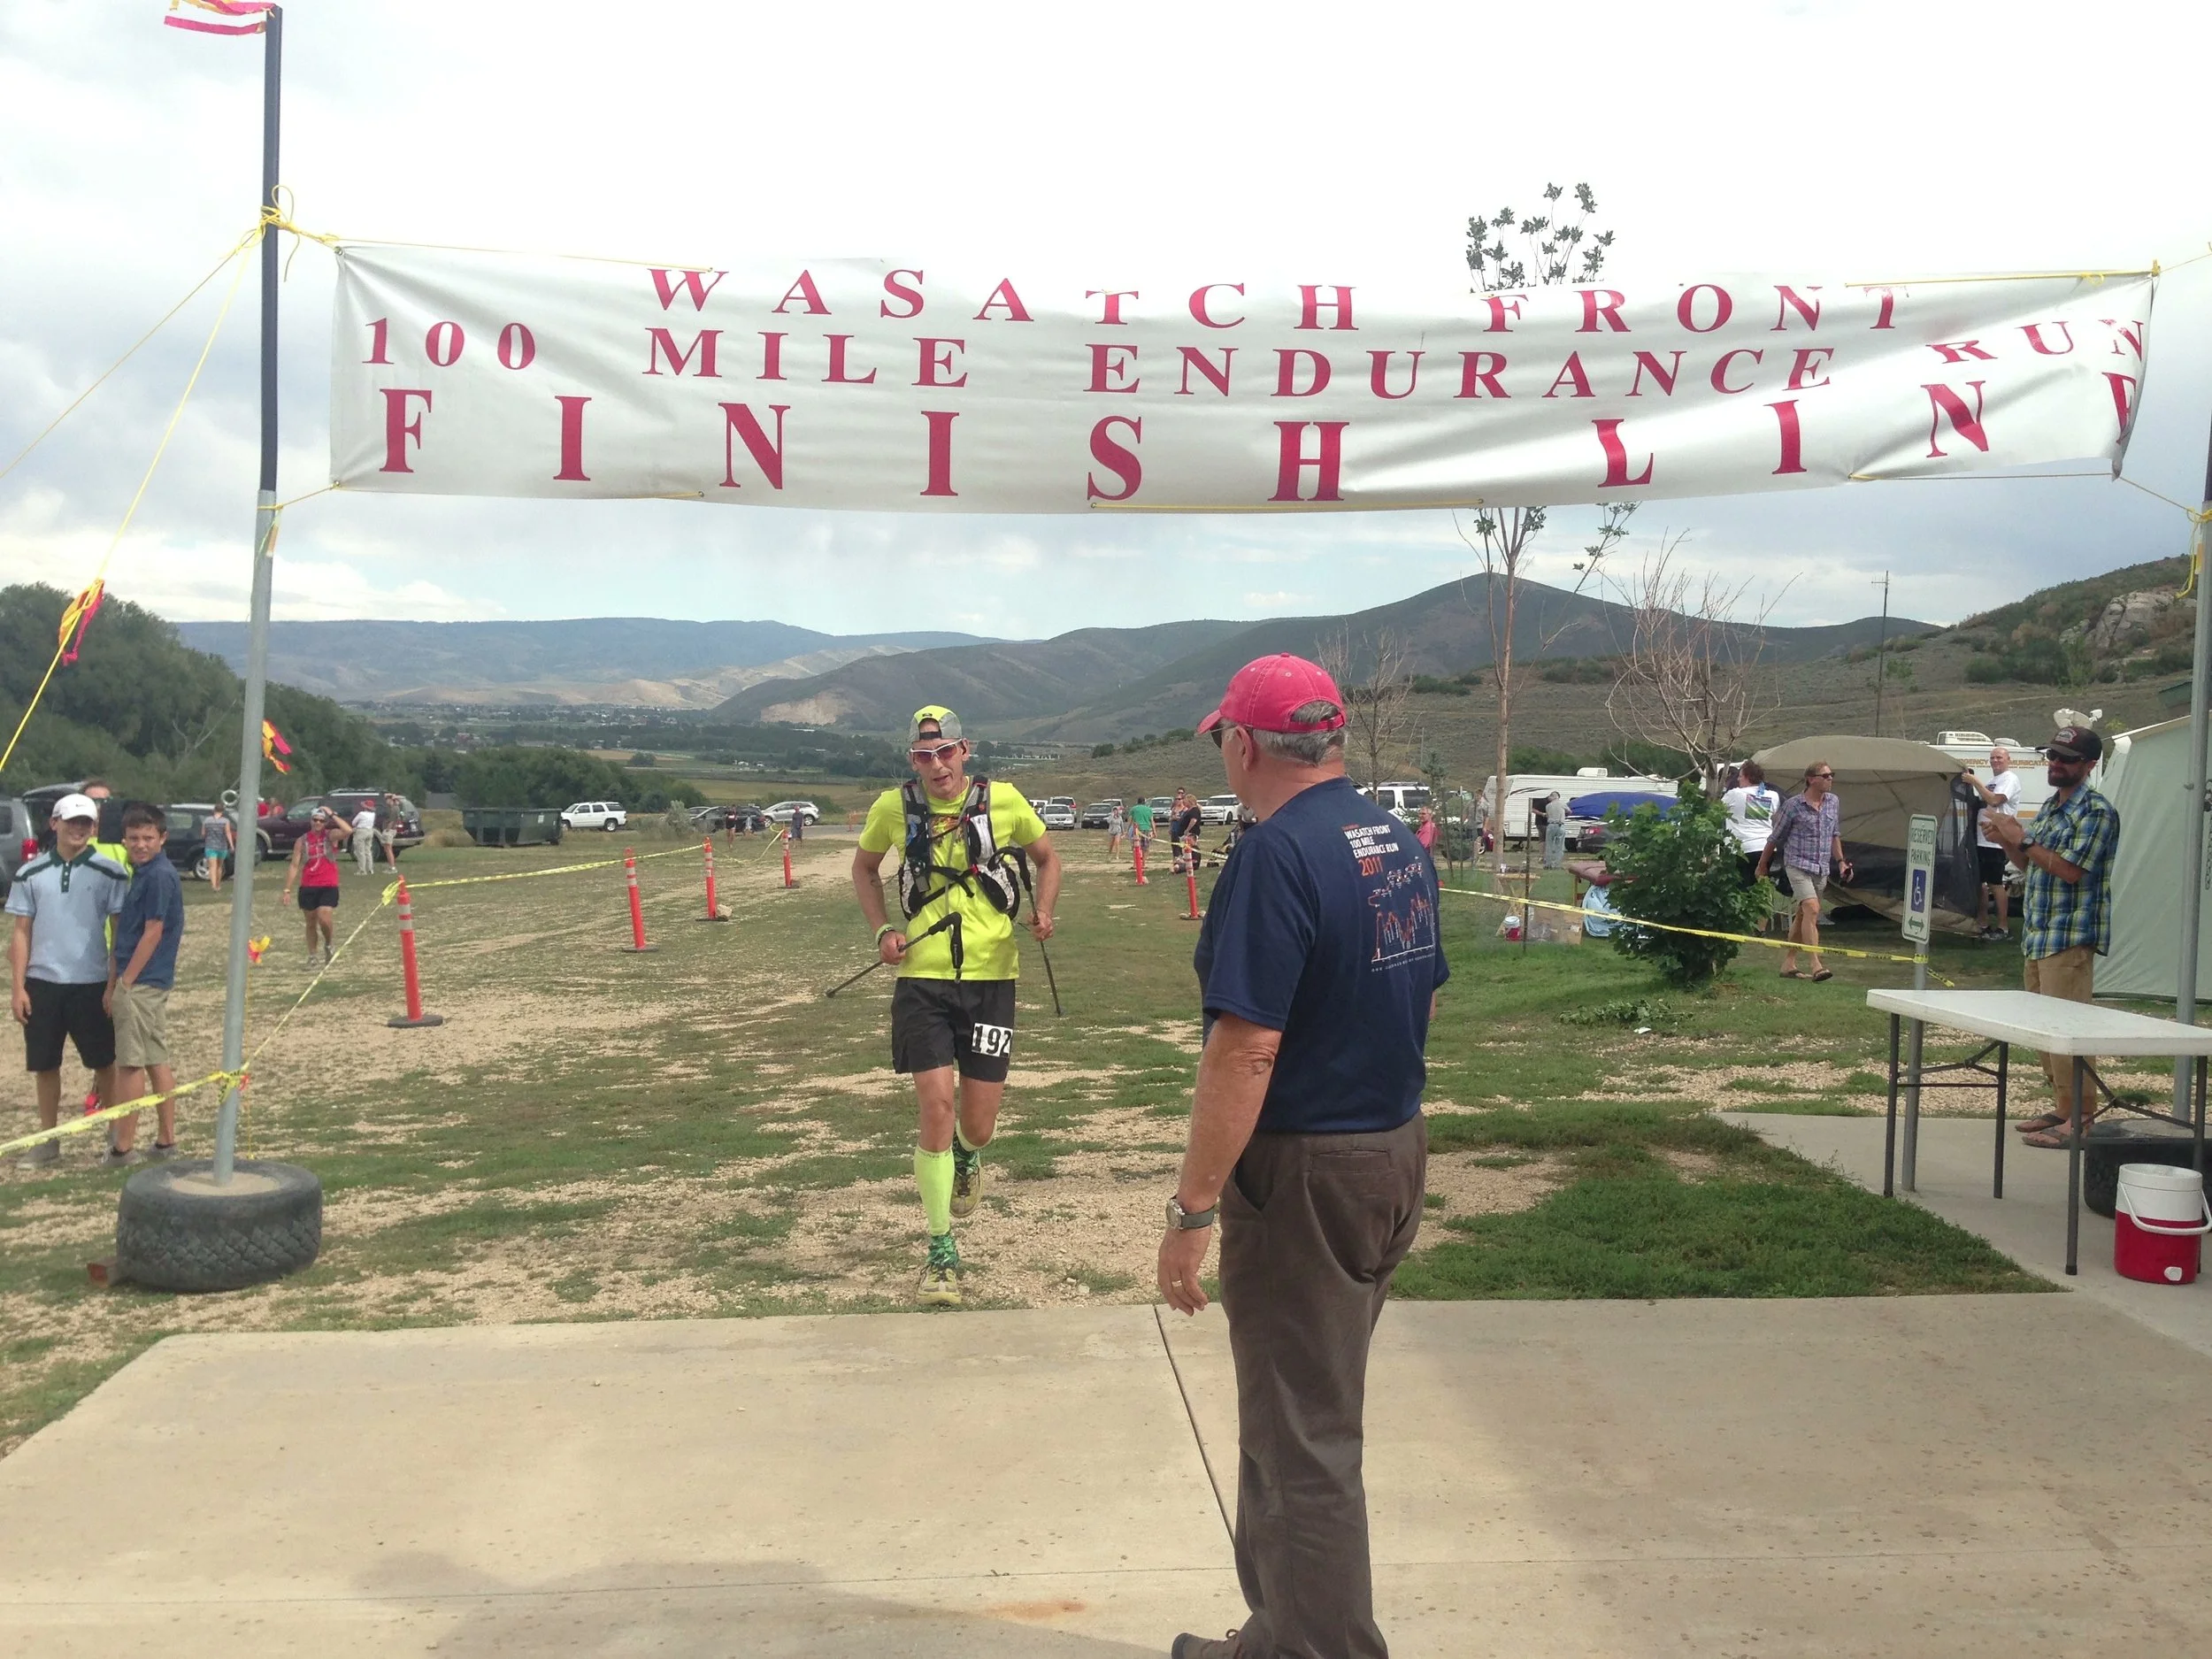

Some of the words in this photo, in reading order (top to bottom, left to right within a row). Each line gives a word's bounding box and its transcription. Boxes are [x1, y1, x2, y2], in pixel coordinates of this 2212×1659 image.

[648, 268, 1359, 331] WASATCH
[1483, 284, 1909, 333] FRONT
[362, 317, 536, 371] 100
[642, 326, 968, 388] MILE
[1083, 340, 1835, 399] ENDURANCE
[1924, 319, 2145, 365] RUN
[380, 389, 1351, 502] FINISH
[1343, 826, 1373, 840] WASATCH
[1372, 824, 1391, 834] FRONT
[1910, 827, 1934, 845] RESERVED
[1349, 839, 1362, 849] 100
[1360, 835, 1375, 847] MILE
[1353, 844, 1386, 858] ENDURANCE
[1385, 841, 1400, 852] RUN
[1357, 856, 1384, 876] 2011
[1910, 849, 1932, 866] PARKING
[972, 1025, 1012, 1058] 192
